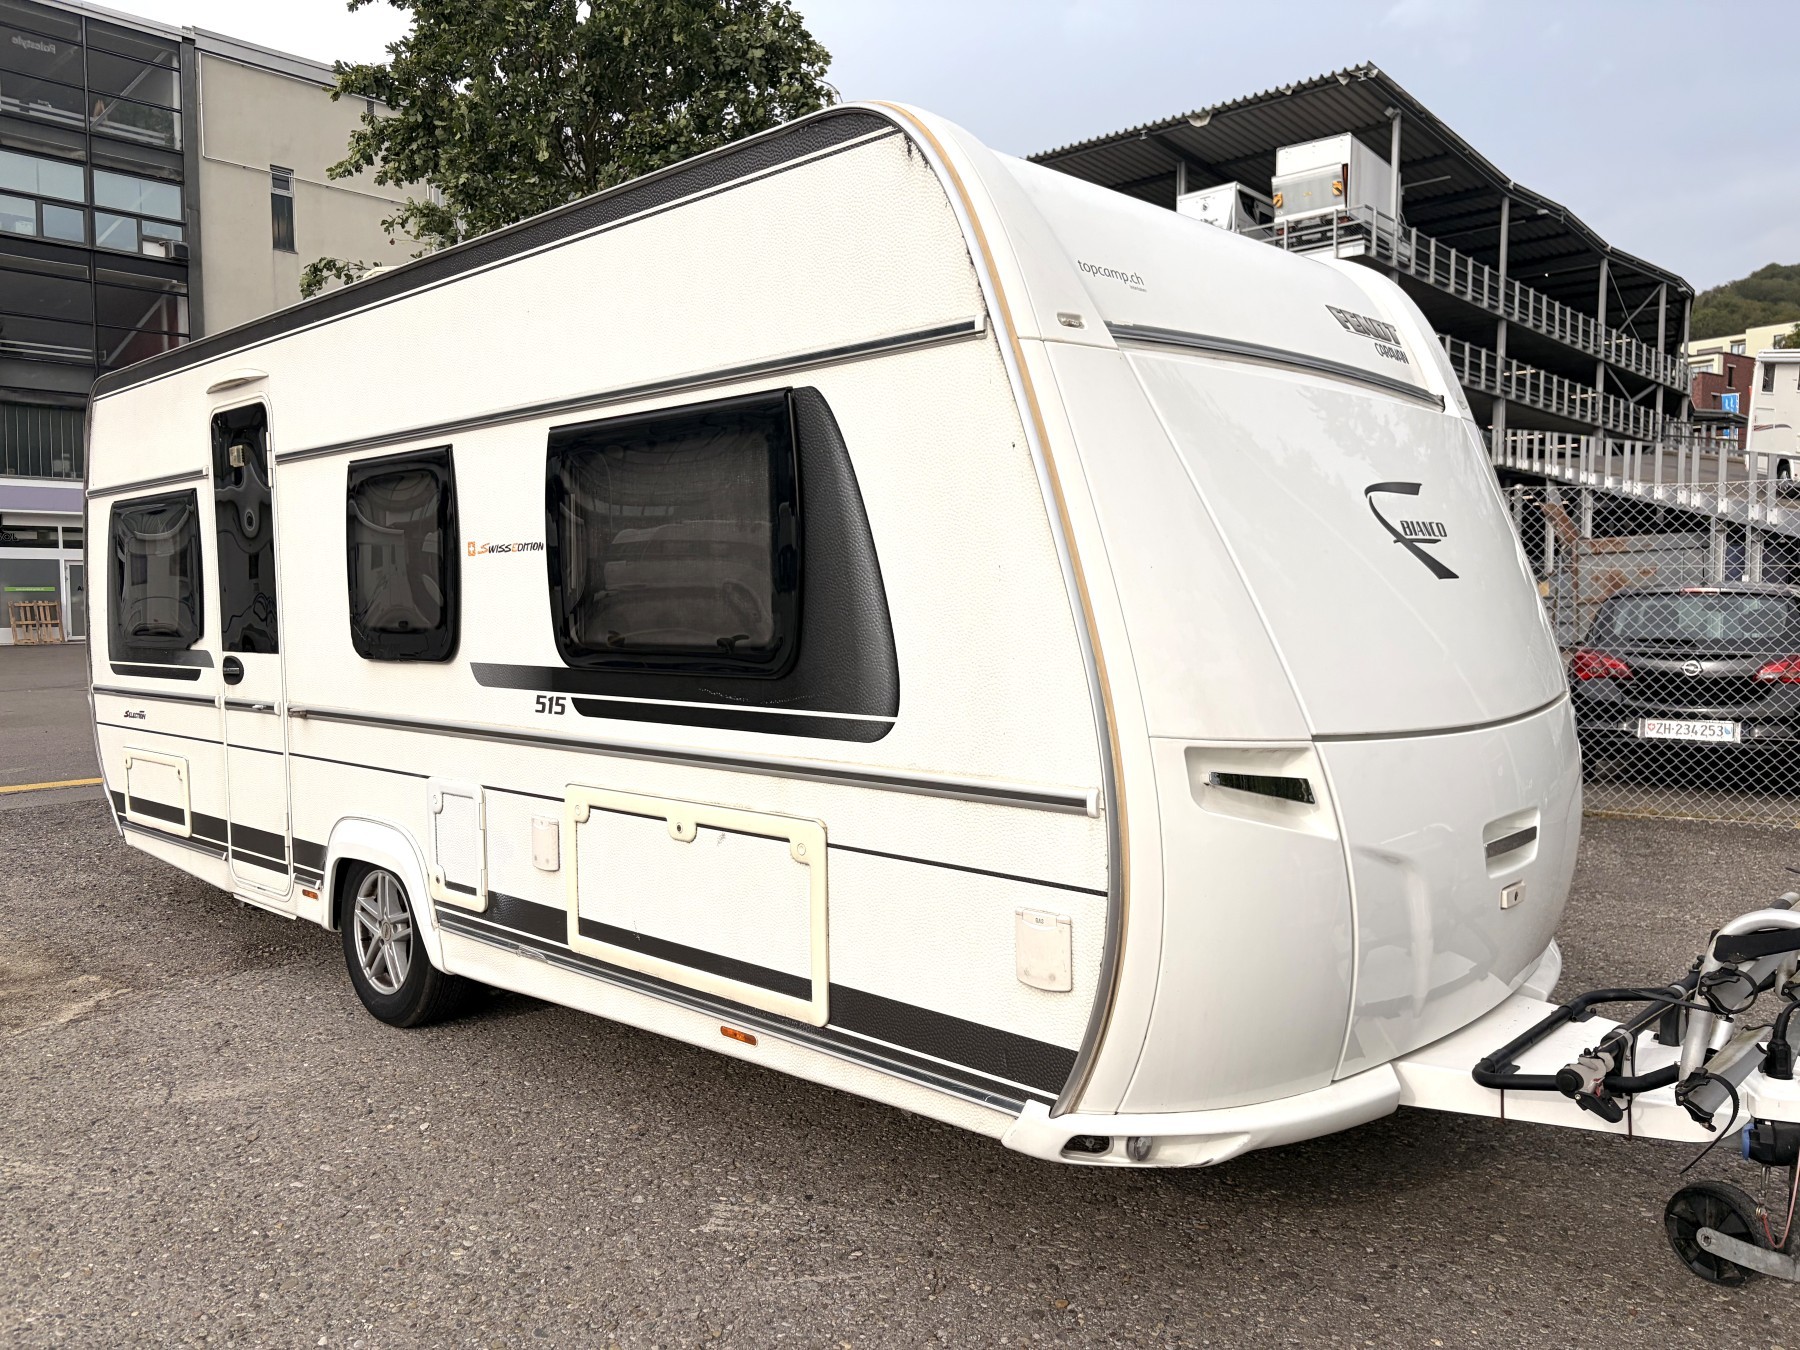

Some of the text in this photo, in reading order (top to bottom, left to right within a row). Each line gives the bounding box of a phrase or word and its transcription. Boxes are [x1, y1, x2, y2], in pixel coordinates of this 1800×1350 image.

[1077, 259, 1145, 286] topcamp.ch
[1325, 304, 1401, 345] FENDT
[1400, 520, 1447, 538] BIANCO
[535, 694, 566, 715] 515
